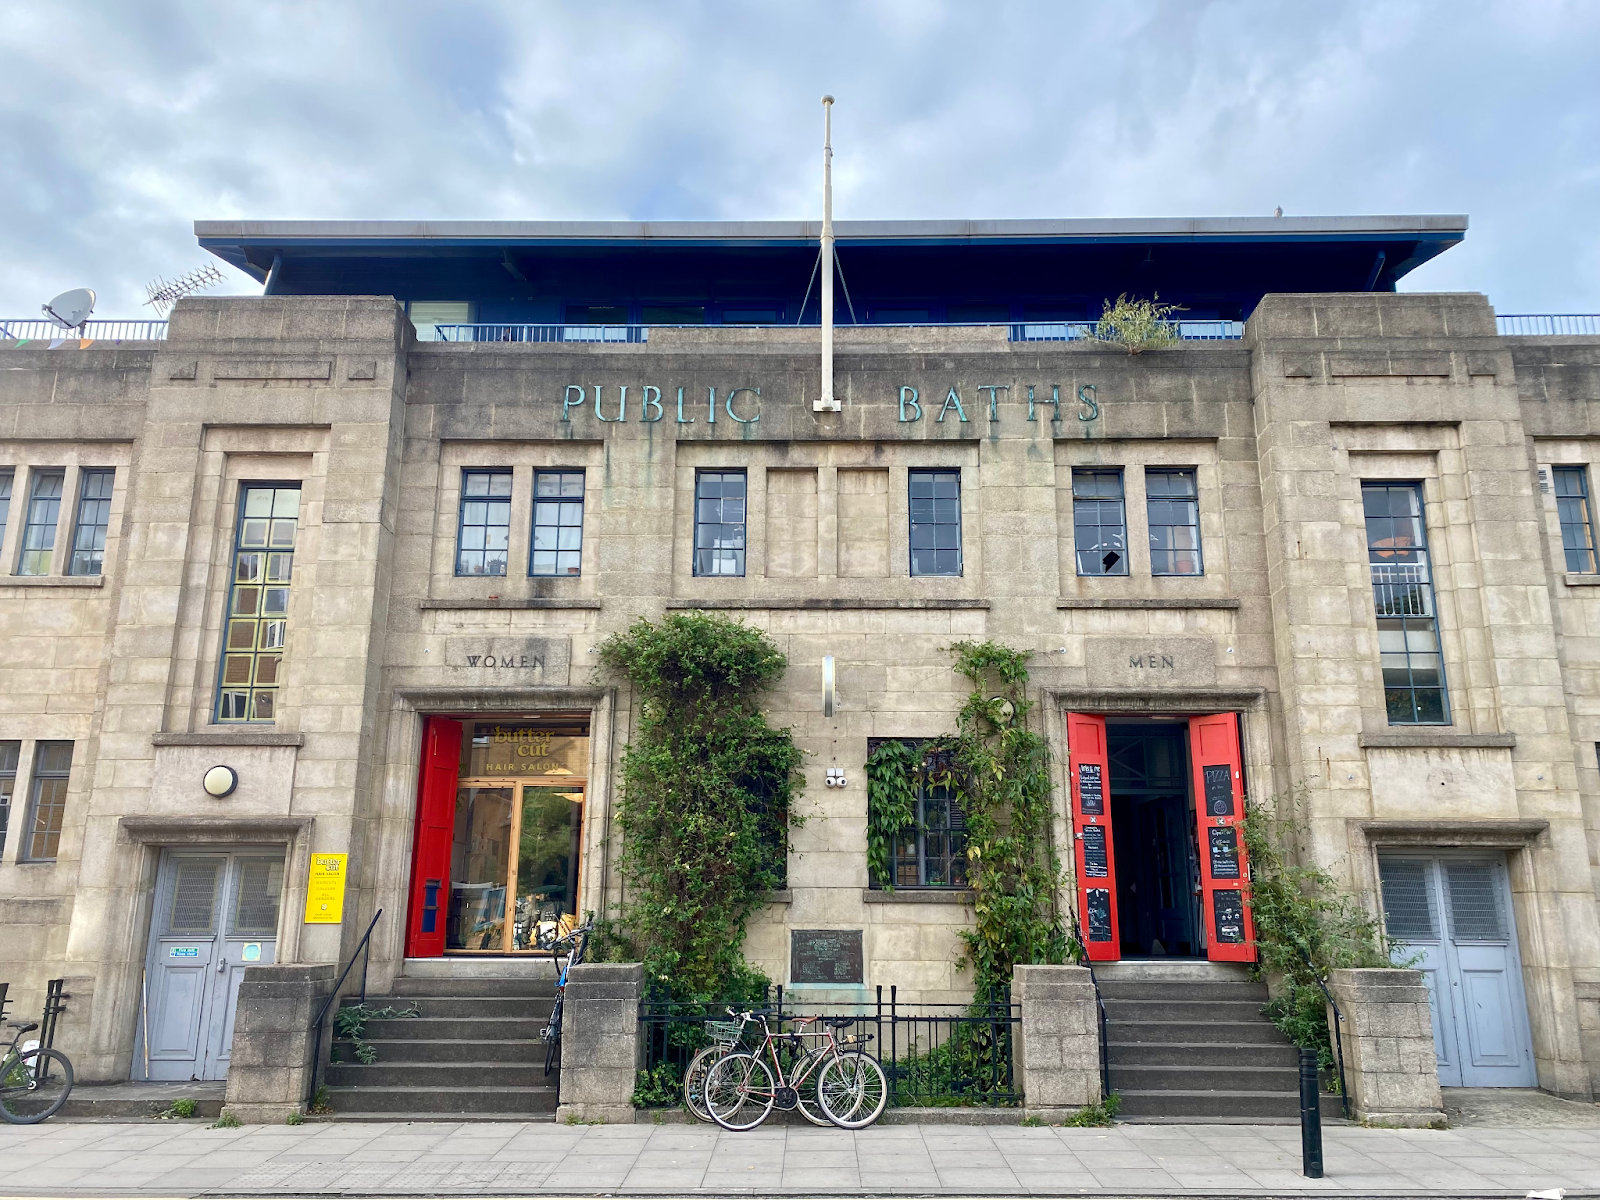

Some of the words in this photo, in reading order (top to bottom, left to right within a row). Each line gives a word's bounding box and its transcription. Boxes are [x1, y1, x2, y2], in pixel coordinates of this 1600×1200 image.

[560, 384, 761, 423] PUBLIC
[897, 384, 1100, 423] BATHS
[466, 655, 546, 669] WOMEN
[1128, 655, 1175, 669] MEN
[494, 725, 555, 744] butter
[517, 742, 551, 758] cut
[486, 763, 515, 771] HAIR
[521, 762, 559, 771] SALON
[1205, 769, 1231, 784] PIZZA
[316, 857, 341, 865] butter
